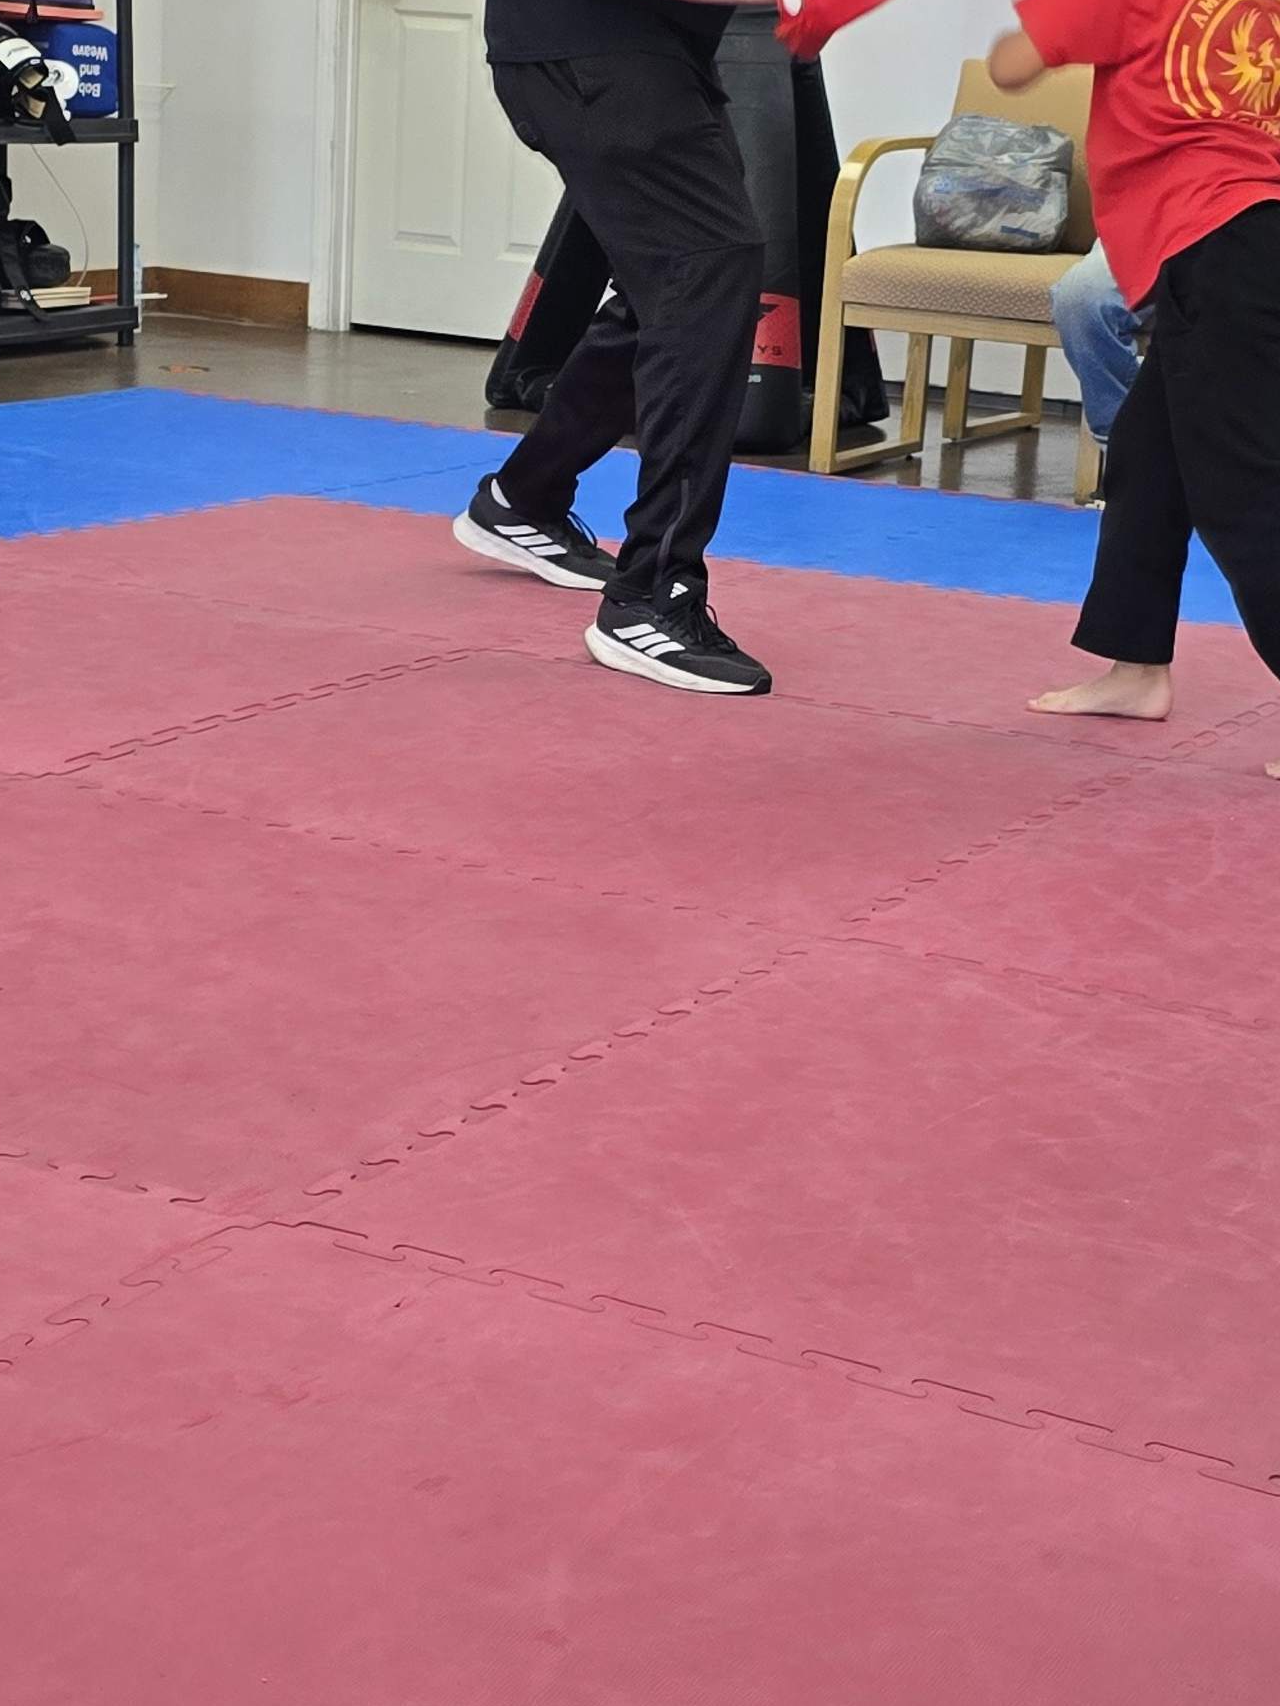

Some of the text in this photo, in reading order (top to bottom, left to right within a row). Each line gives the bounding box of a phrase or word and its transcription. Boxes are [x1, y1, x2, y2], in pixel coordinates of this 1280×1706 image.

[71, 43, 109, 62] Weave
[78, 63, 101, 78] and
[78, 81, 102, 98] Bob
